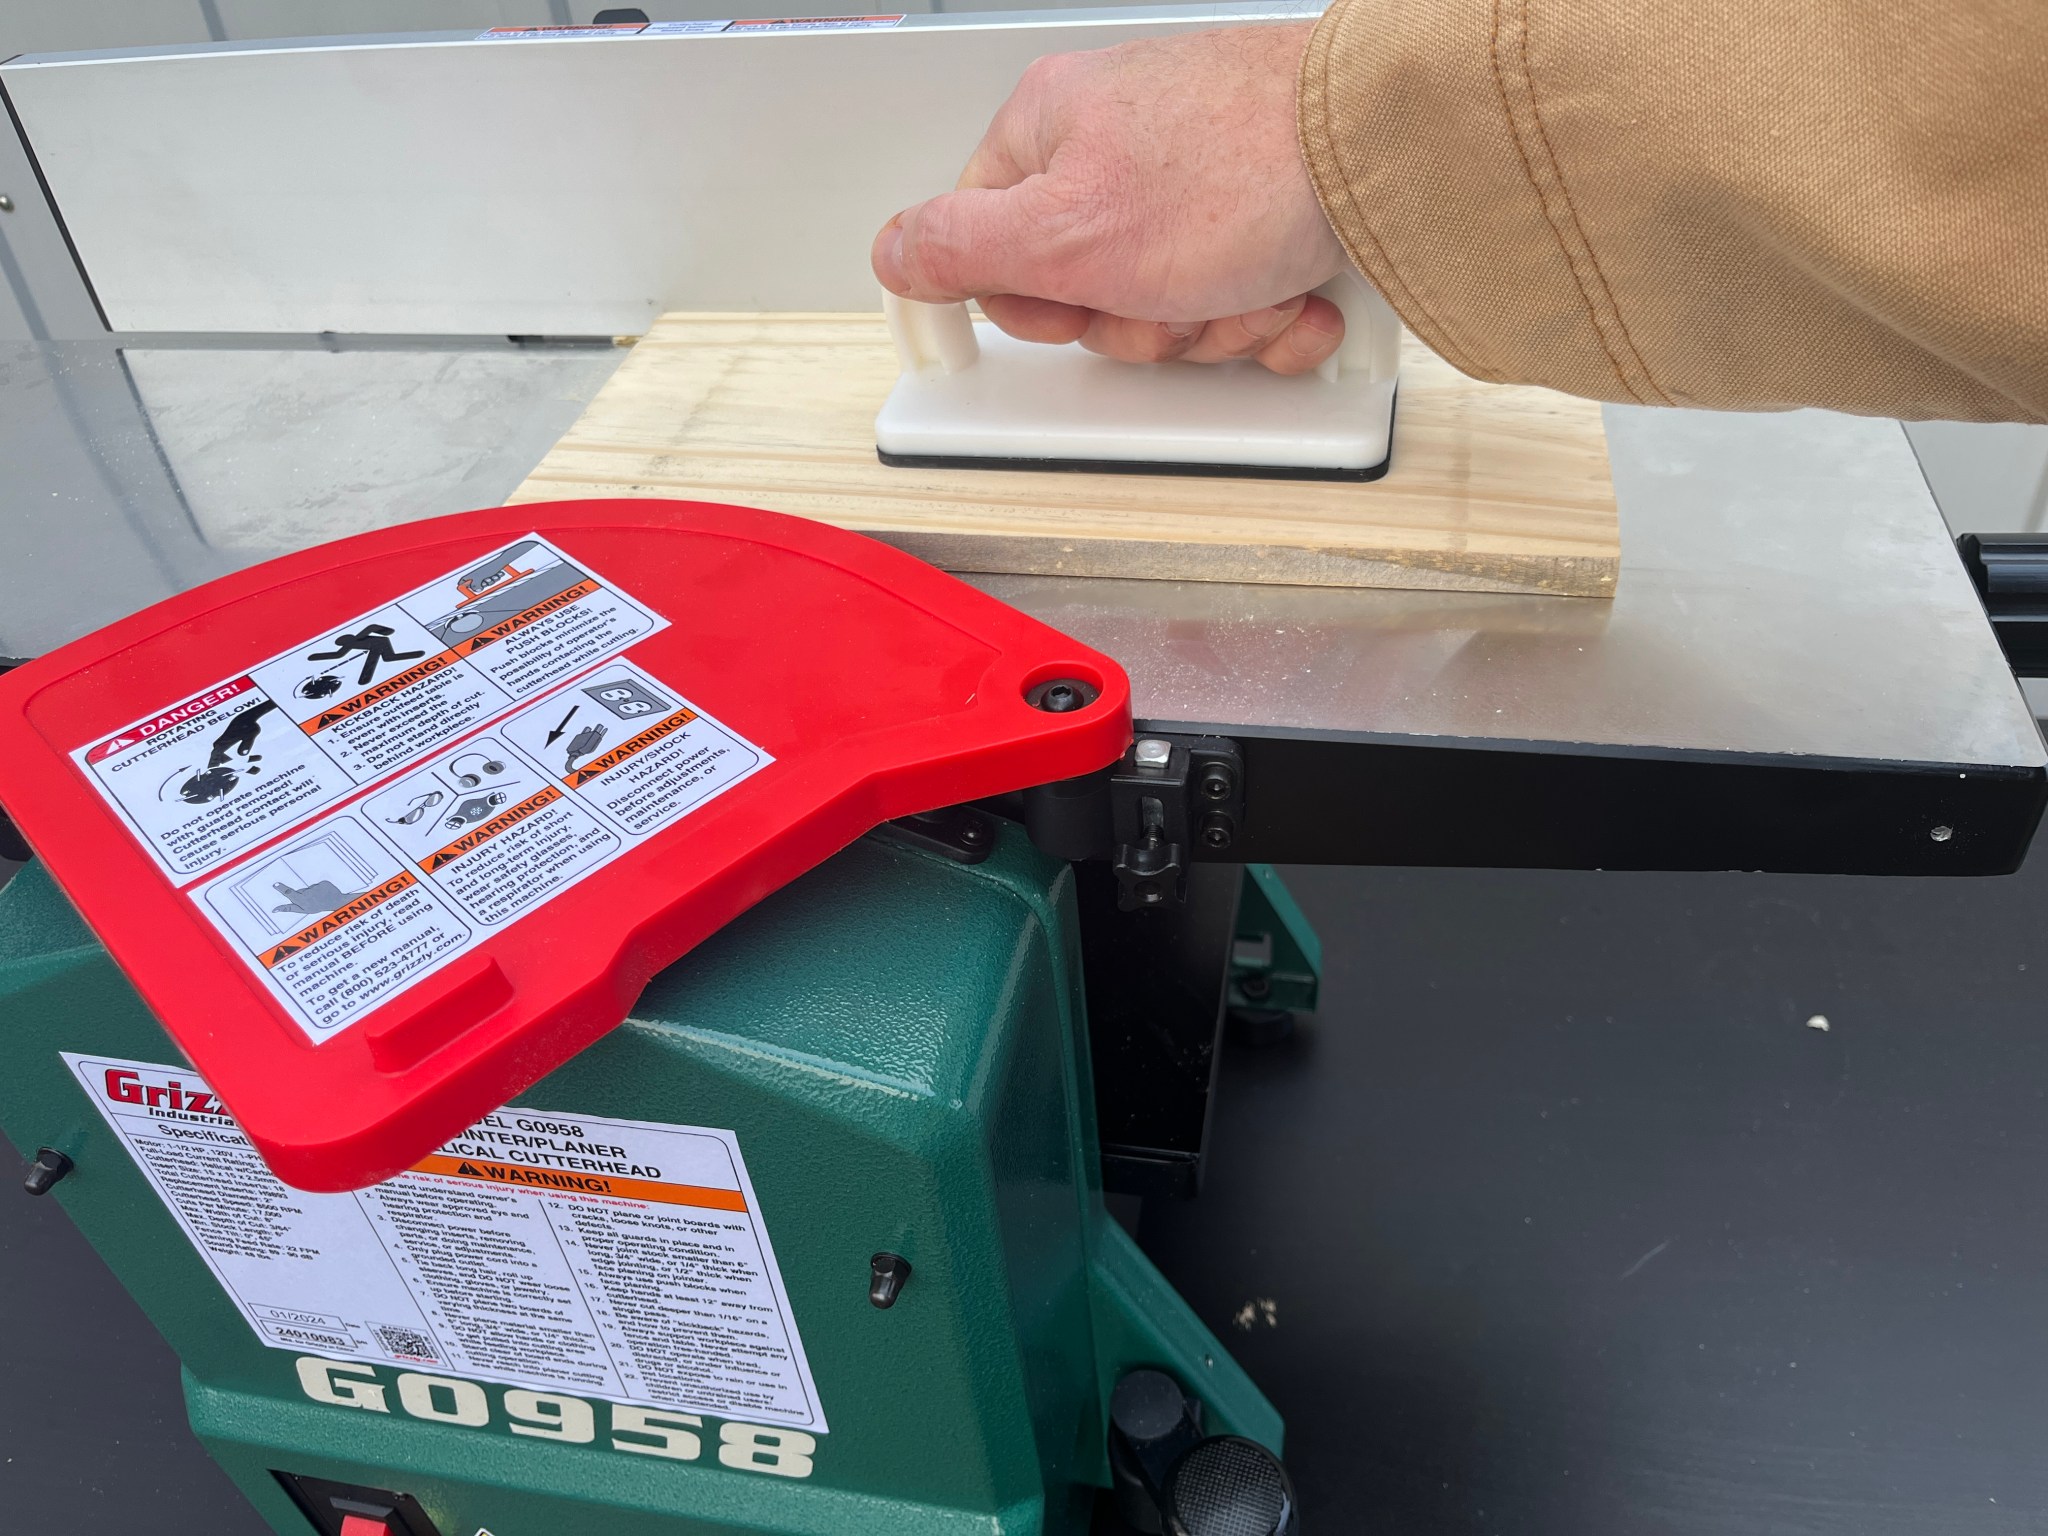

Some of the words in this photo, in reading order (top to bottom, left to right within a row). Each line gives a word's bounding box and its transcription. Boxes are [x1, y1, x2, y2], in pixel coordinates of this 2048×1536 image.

[540, 24, 613, 32] WARNING!
[790, 16, 866, 25] WARNING!
[489, 657, 519, 674] Push
[517, 639, 554, 659] blocks
[554, 615, 599, 641] minimize
[598, 606, 617, 617] the
[490, 585, 589, 636] WARNING!
[504, 617, 554, 646] ALWAYS
[553, 604, 580, 619] USE
[505, 634, 541, 655] PUSH
[539, 607, 593, 637] BLOCKS!
[498, 649, 552, 681] possibility
[553, 642, 565, 652] of
[565, 617, 617, 645] operator's
[505, 667, 541, 687] hands
[541, 638, 596, 669] contacting
[594, 629, 613, 640] the
[515, 661, 572, 693] cutterhead
[571, 647, 600, 663] while
[600, 628, 638, 649] cutting.
[138, 683, 240, 736] DANGER!
[330, 695, 400, 734] KICKBACK
[400, 666, 457, 698] HAZARD!
[339, 716, 381, 739] Ensure
[382, 692, 425, 717] outfeed
[424, 679, 452, 695] table
[340, 656, 447, 713] WARNING!
[111, 724, 205, 772] CUTTERHEAD
[206, 696, 261, 726] BELOW!
[145, 709, 217, 746] ROTATING
[339, 750, 352, 758] 2.
[352, 730, 386, 751] Never
[388, 709, 429, 733] exceed
[428, 699, 448, 711] the
[347, 728, 376, 744] even
[376, 714, 402, 729] with
[399, 693, 445, 717] inserts.
[352, 763, 366, 771] 3.
[365, 752, 384, 764] Do
[385, 740, 406, 754] not
[406, 722, 439, 743] stand
[439, 701, 480, 725] directly
[360, 726, 416, 757] maximum
[416, 708, 450, 727] depth
[450, 700, 462, 710] of
[463, 690, 485, 703] cut.
[372, 745, 414, 770] behind
[414, 716, 475, 748] workpiece.
[594, 712, 690, 768] WARNING!
[599, 731, 691, 786] INJURY/SHOCK
[605, 767, 674, 810] Disconnect
[674, 746, 709, 771] power
[614, 791, 655, 817] before
[655, 748, 730, 792] adjustments,
[627, 748, 685, 783] HAZARD!
[159, 828, 180, 840] Do
[181, 815, 204, 830] not
[205, 791, 253, 817] operate
[254, 764, 306, 793] machine
[166, 831, 195, 847] with
[196, 809, 234, 833] guard
[235, 778, 293, 812] removed!
[172, 814, 243, 854] Cutterhead
[244, 790, 291, 817] contact
[291, 778, 314, 792] will
[178, 839, 217, 862] cause
[219, 814, 267, 841] serious
[268, 784, 322, 817] personal
[453, 790, 556, 851] WARNING!
[624, 775, 704, 823] maintenance,
[703, 764, 716, 775] or
[633, 801, 681, 830] service.
[183, 846, 227, 870] injury.
[446, 877, 464, 887] To
[464, 852, 505, 878] reduce
[505, 838, 529, 854] risk
[529, 828, 542, 839] of
[542, 811, 573, 831] short
[450, 842, 498, 874] INJURY
[499, 808, 558, 845] HAZARD!
[455, 877, 479, 895] and
[478, 845, 535, 881] long-term
[534, 824, 572, 847] injury,
[461, 882, 491, 902] wear
[492, 859, 528, 884] safety
[529, 833, 577, 863] glasses,
[468, 879, 516, 909] hearing
[515, 843, 578, 882] protection,
[578, 826, 601, 843] and
[477, 908, 487, 916] a
[487, 872, 544, 910] respirator
[545, 853, 577, 874] when
[577, 833, 611, 854] using
[484, 907, 509, 923] this
[509, 875, 563, 908] machine.
[277, 961, 296, 972] To
[297, 934, 342, 962] reduce
[343, 918, 369, 935] risk
[369, 908, 383, 920] of
[384, 888, 420, 911] death
[285, 970, 299, 981] or
[302, 941, 350, 971] serious
[350, 918, 392, 942] injury,
[392, 897, 421, 918] read
[297, 875, 410, 943] WARNING!
[292, 957, 340, 989] manual
[340, 923, 396, 960] BEFORE
[397, 903, 433, 926] using
[305, 994, 325, 1006] To
[327, 978, 350, 996] get
[351, 972, 360, 981] a
[361, 955, 388, 974] new
[389, 925, 440, 957] manual,
[314, 996, 339, 1015] call
[340, 976, 374, 1000] (800)
[373, 940, 428, 978] 523-4777
[431, 931, 445, 943] or
[298, 961, 358, 997] machine.
[321, 1010, 340, 1023] go
[340, 999, 356, 1011] to
[358, 933, 466, 1000] www.grizzly.com.
[515, 1118, 585, 1138] G0958
[445, 1179, 484, 1189] serious
[485, 1183, 515, 1194] injury
[517, 1188, 545, 1196] when
[547, 1192, 577, 1202] using
[578, 1195, 599, 1203] this
[482, 1165, 611, 1193] WARNING!
[507, 1149, 661, 1178] CUTTERHEAD
[570, 1212, 609, 1223] cracks,
[609, 1216, 639, 1226] loose
[640, 1220, 675, 1231] knots,
[689, 1227, 718, 1236] other
[574, 1219, 615, 1230] defects.
[269, 1309, 326, 1325] 01/2024
[295, 1357, 817, 1478] G0958
